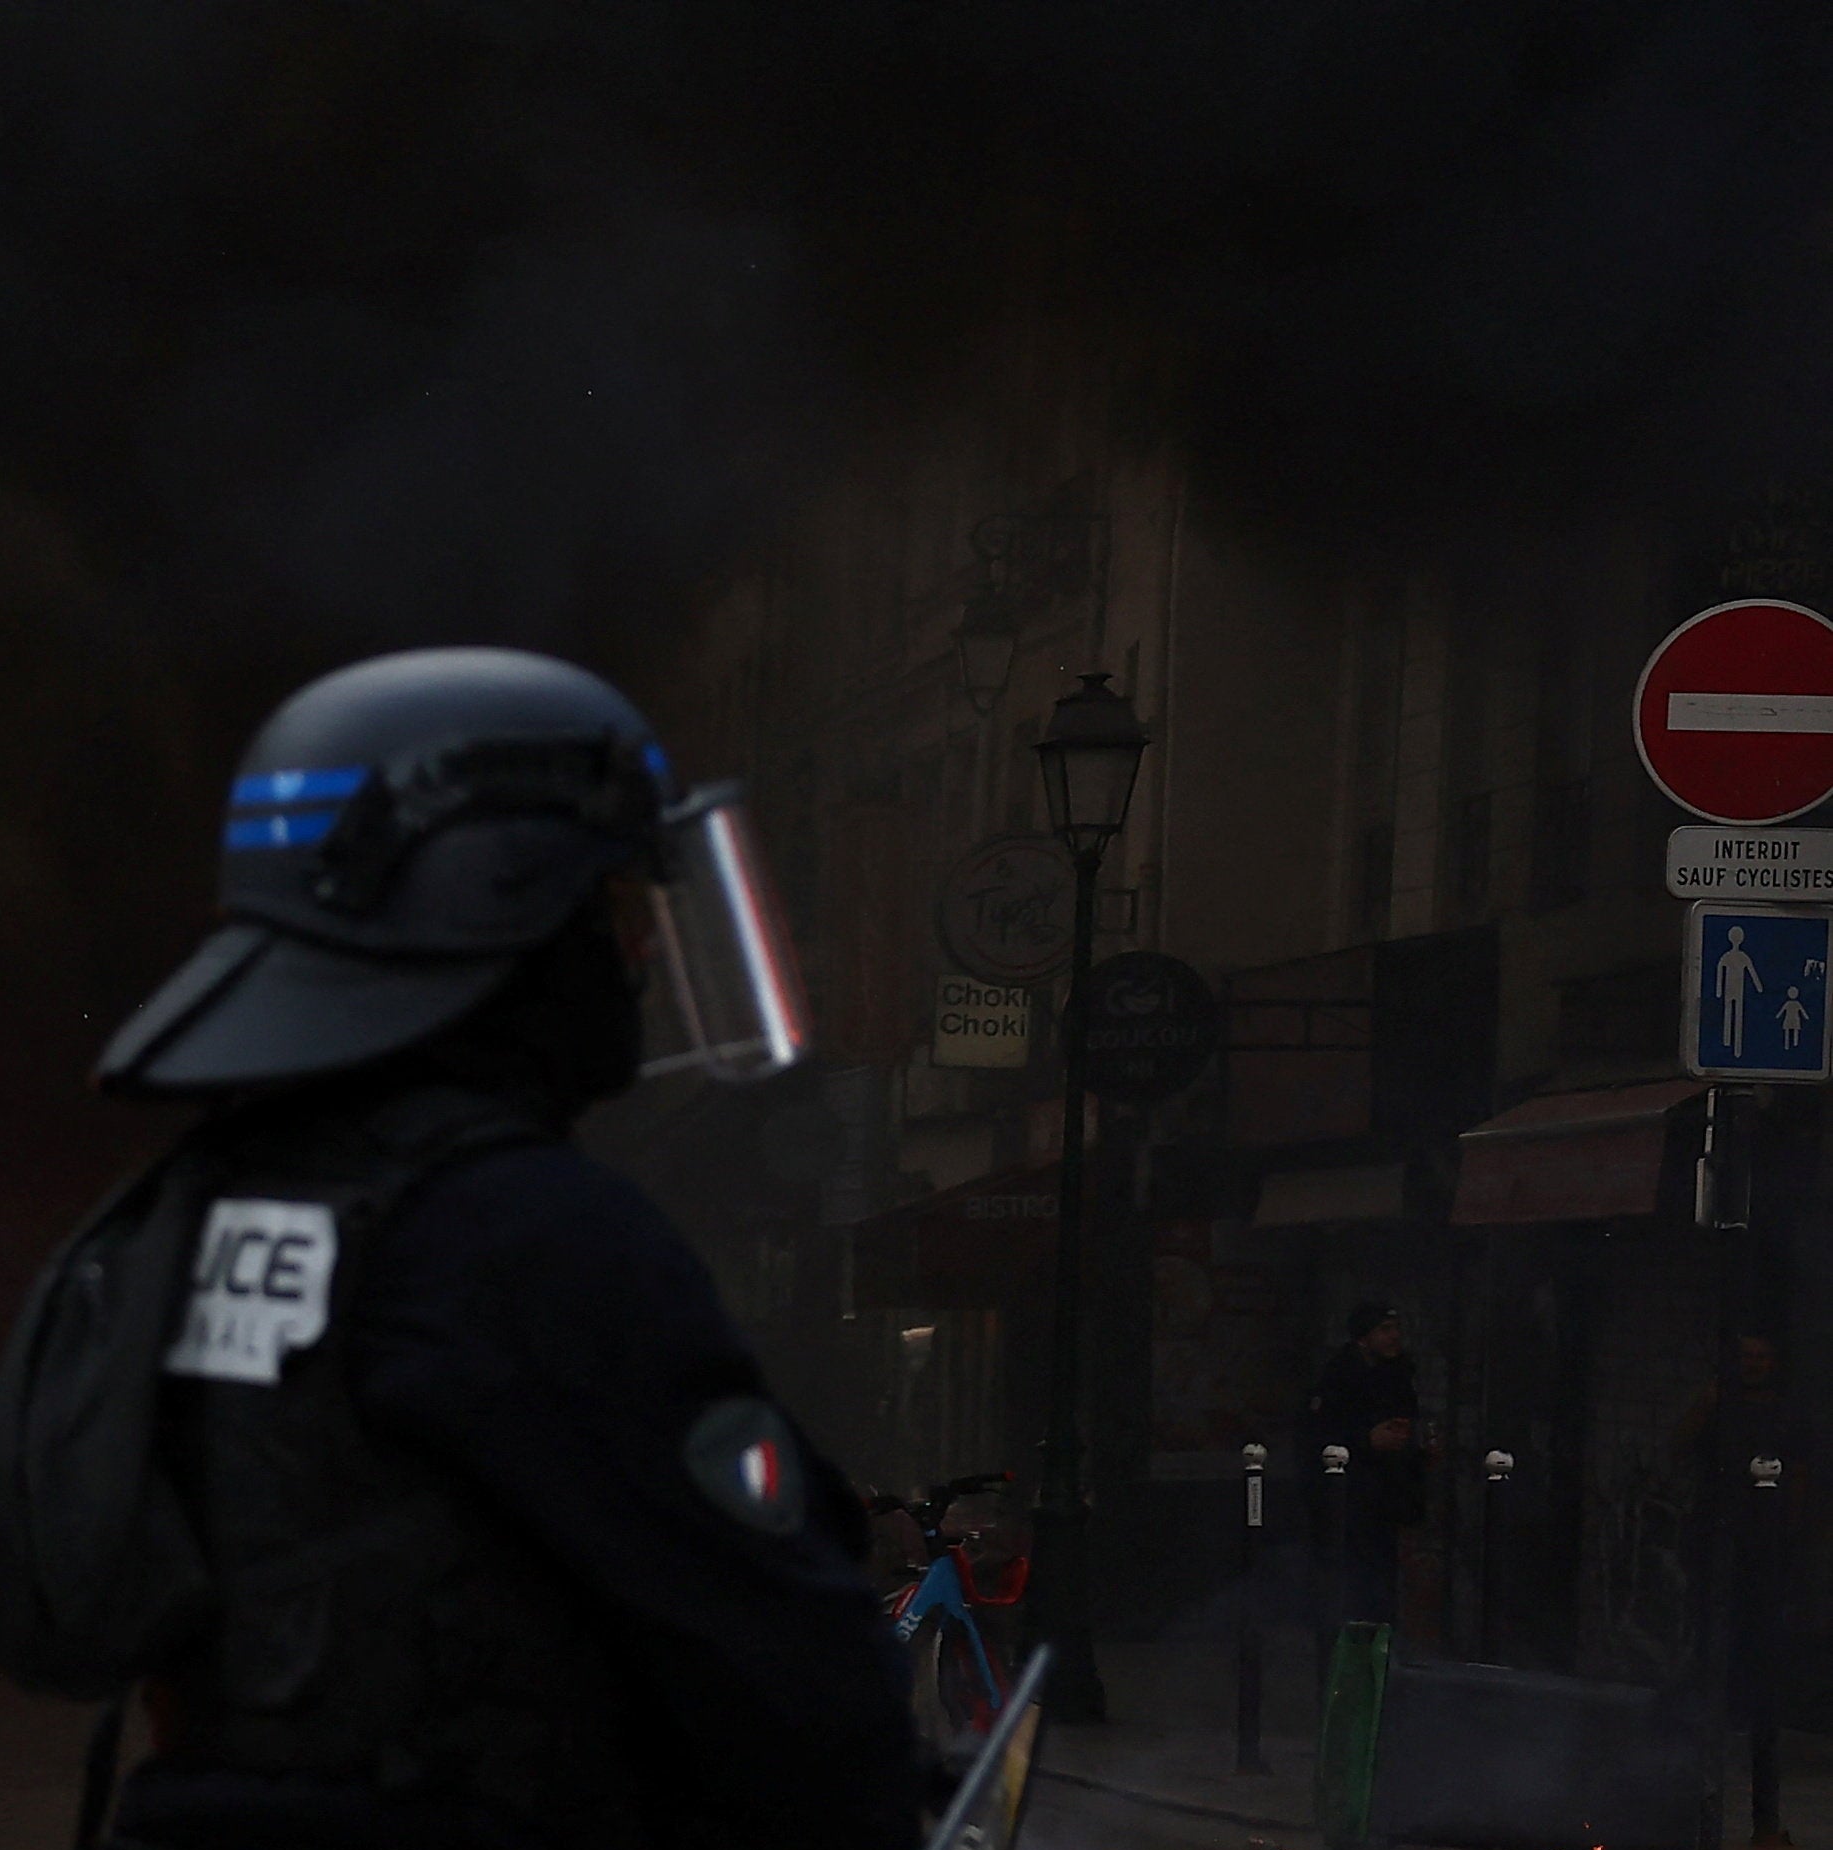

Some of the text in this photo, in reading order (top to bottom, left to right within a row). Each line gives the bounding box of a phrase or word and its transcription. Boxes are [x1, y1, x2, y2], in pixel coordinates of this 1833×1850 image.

[1714, 839, 1800, 860] INTERDIT
[1676, 867, 1833, 889] SAUF CYCLISTES
[942, 982, 1029, 1008] Choki
[940, 1012, 1026, 1037] Choki
